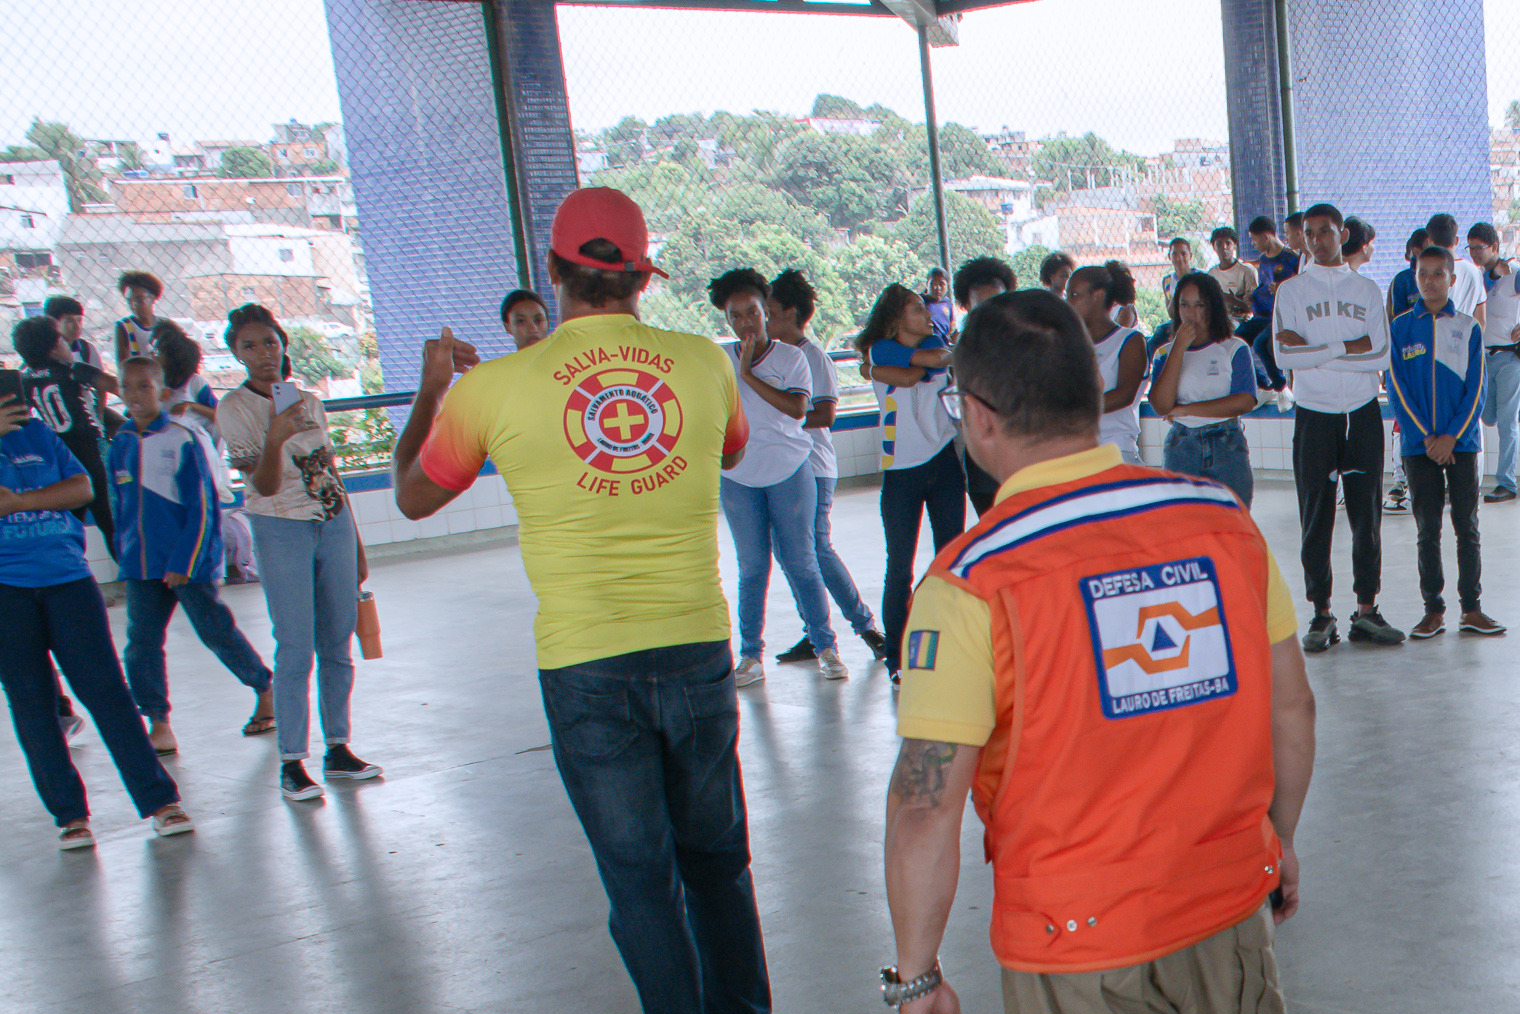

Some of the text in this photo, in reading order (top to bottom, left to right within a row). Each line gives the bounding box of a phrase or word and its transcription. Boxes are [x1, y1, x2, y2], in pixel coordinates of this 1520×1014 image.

[1306, 301, 1367, 323] NIKE
[553, 345, 675, 386] SALVA-VIDAS
[31, 384, 72, 433] 10
[588, 388, 625, 421] SALVAMENTO
[576, 455, 688, 496] LIFE GUARD
[1088, 562, 1208, 599] DEFESA CIVIL
[1112, 677, 1230, 714] LAURO DE FREITAS-BA
